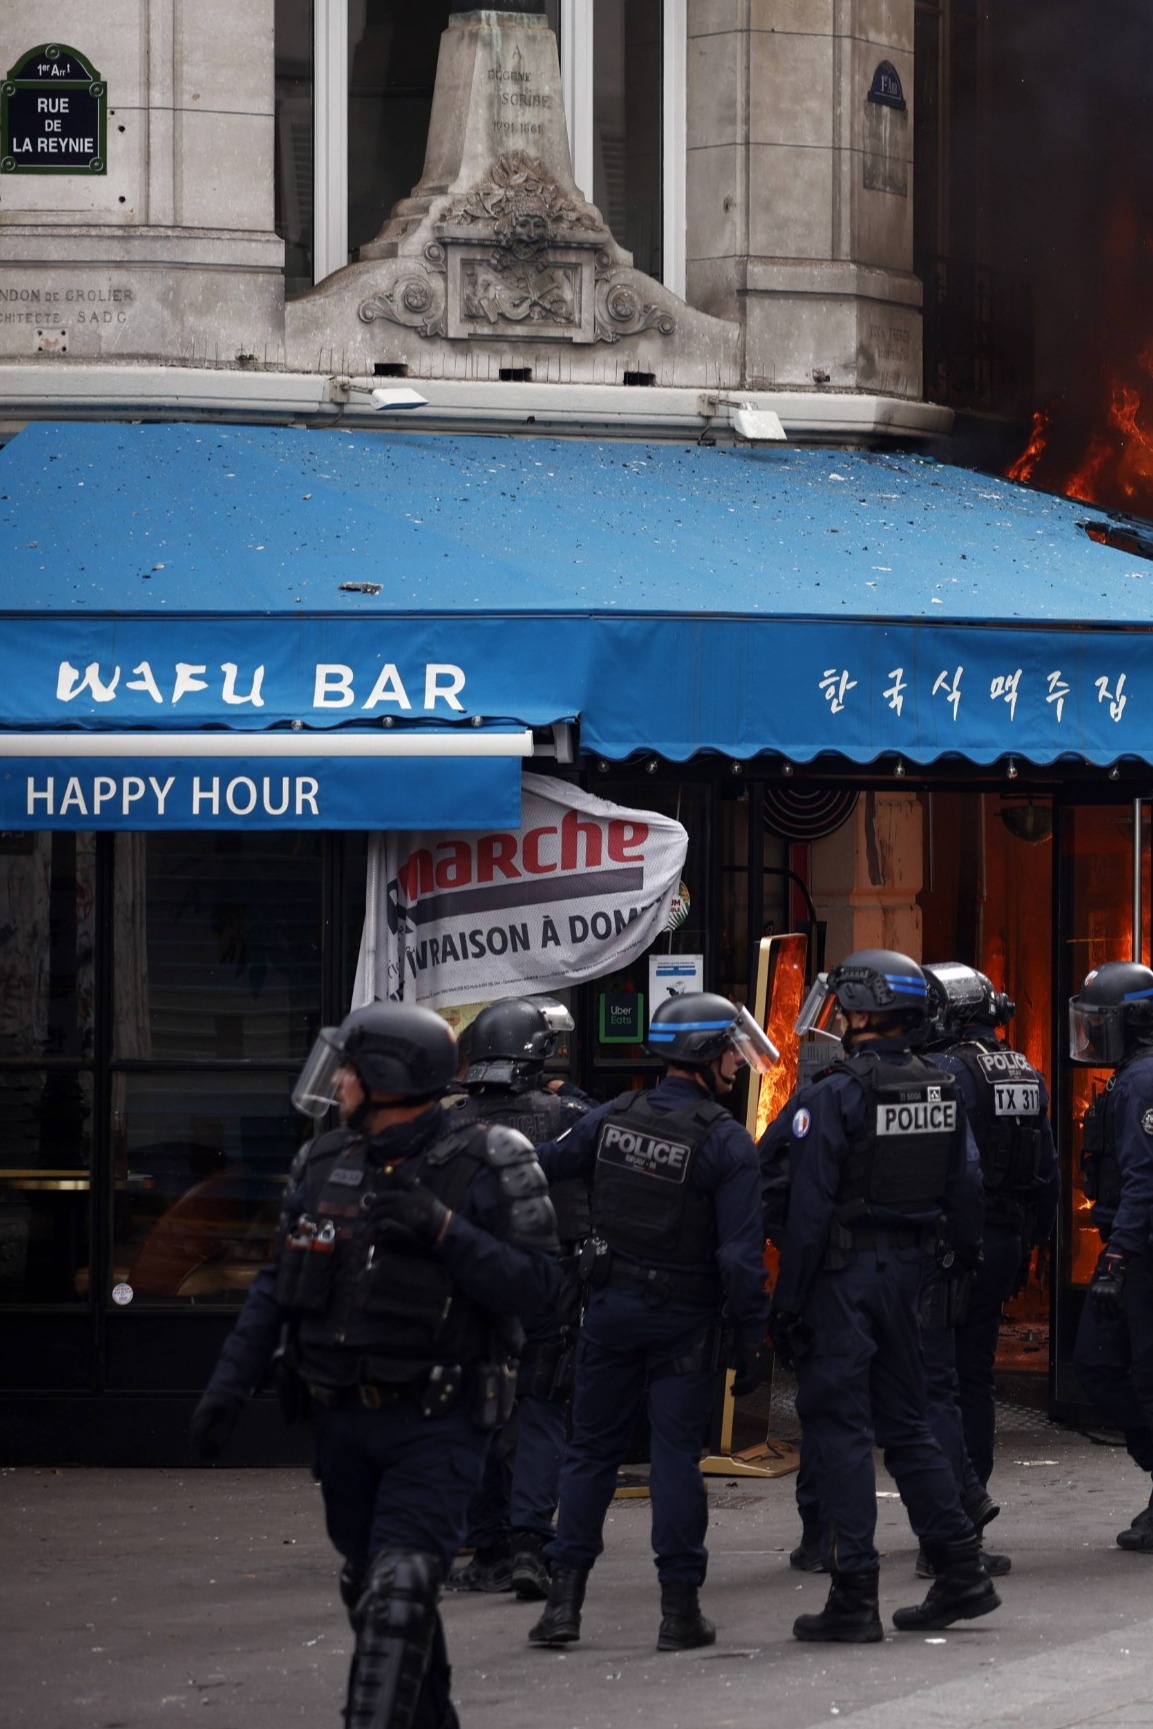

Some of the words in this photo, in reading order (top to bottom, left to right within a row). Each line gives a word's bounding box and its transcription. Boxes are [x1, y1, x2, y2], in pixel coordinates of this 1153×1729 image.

[37, 98, 70, 113] RUE
[44, 119, 62, 132] DE
[13, 137, 33, 153] LA
[37, 137, 94, 153] REYNIE
[65, 289, 134, 302] GROLIER
[56, 660, 265, 706] WAFU
[313, 663, 467, 709] BAR
[26, 776, 176, 815] HAPPY
[192, 776, 320, 815] HOUR
[541, 915, 561, 948] À
[610, 1005, 632, 1016] Uber
[610, 1015, 632, 1025] Eats
[996, 1089, 1017, 1110] TX
[1022, 1089, 1040, 1110] 311
[886, 1105, 954, 1131] POLICE
[605, 1129, 686, 1169] POLICE
